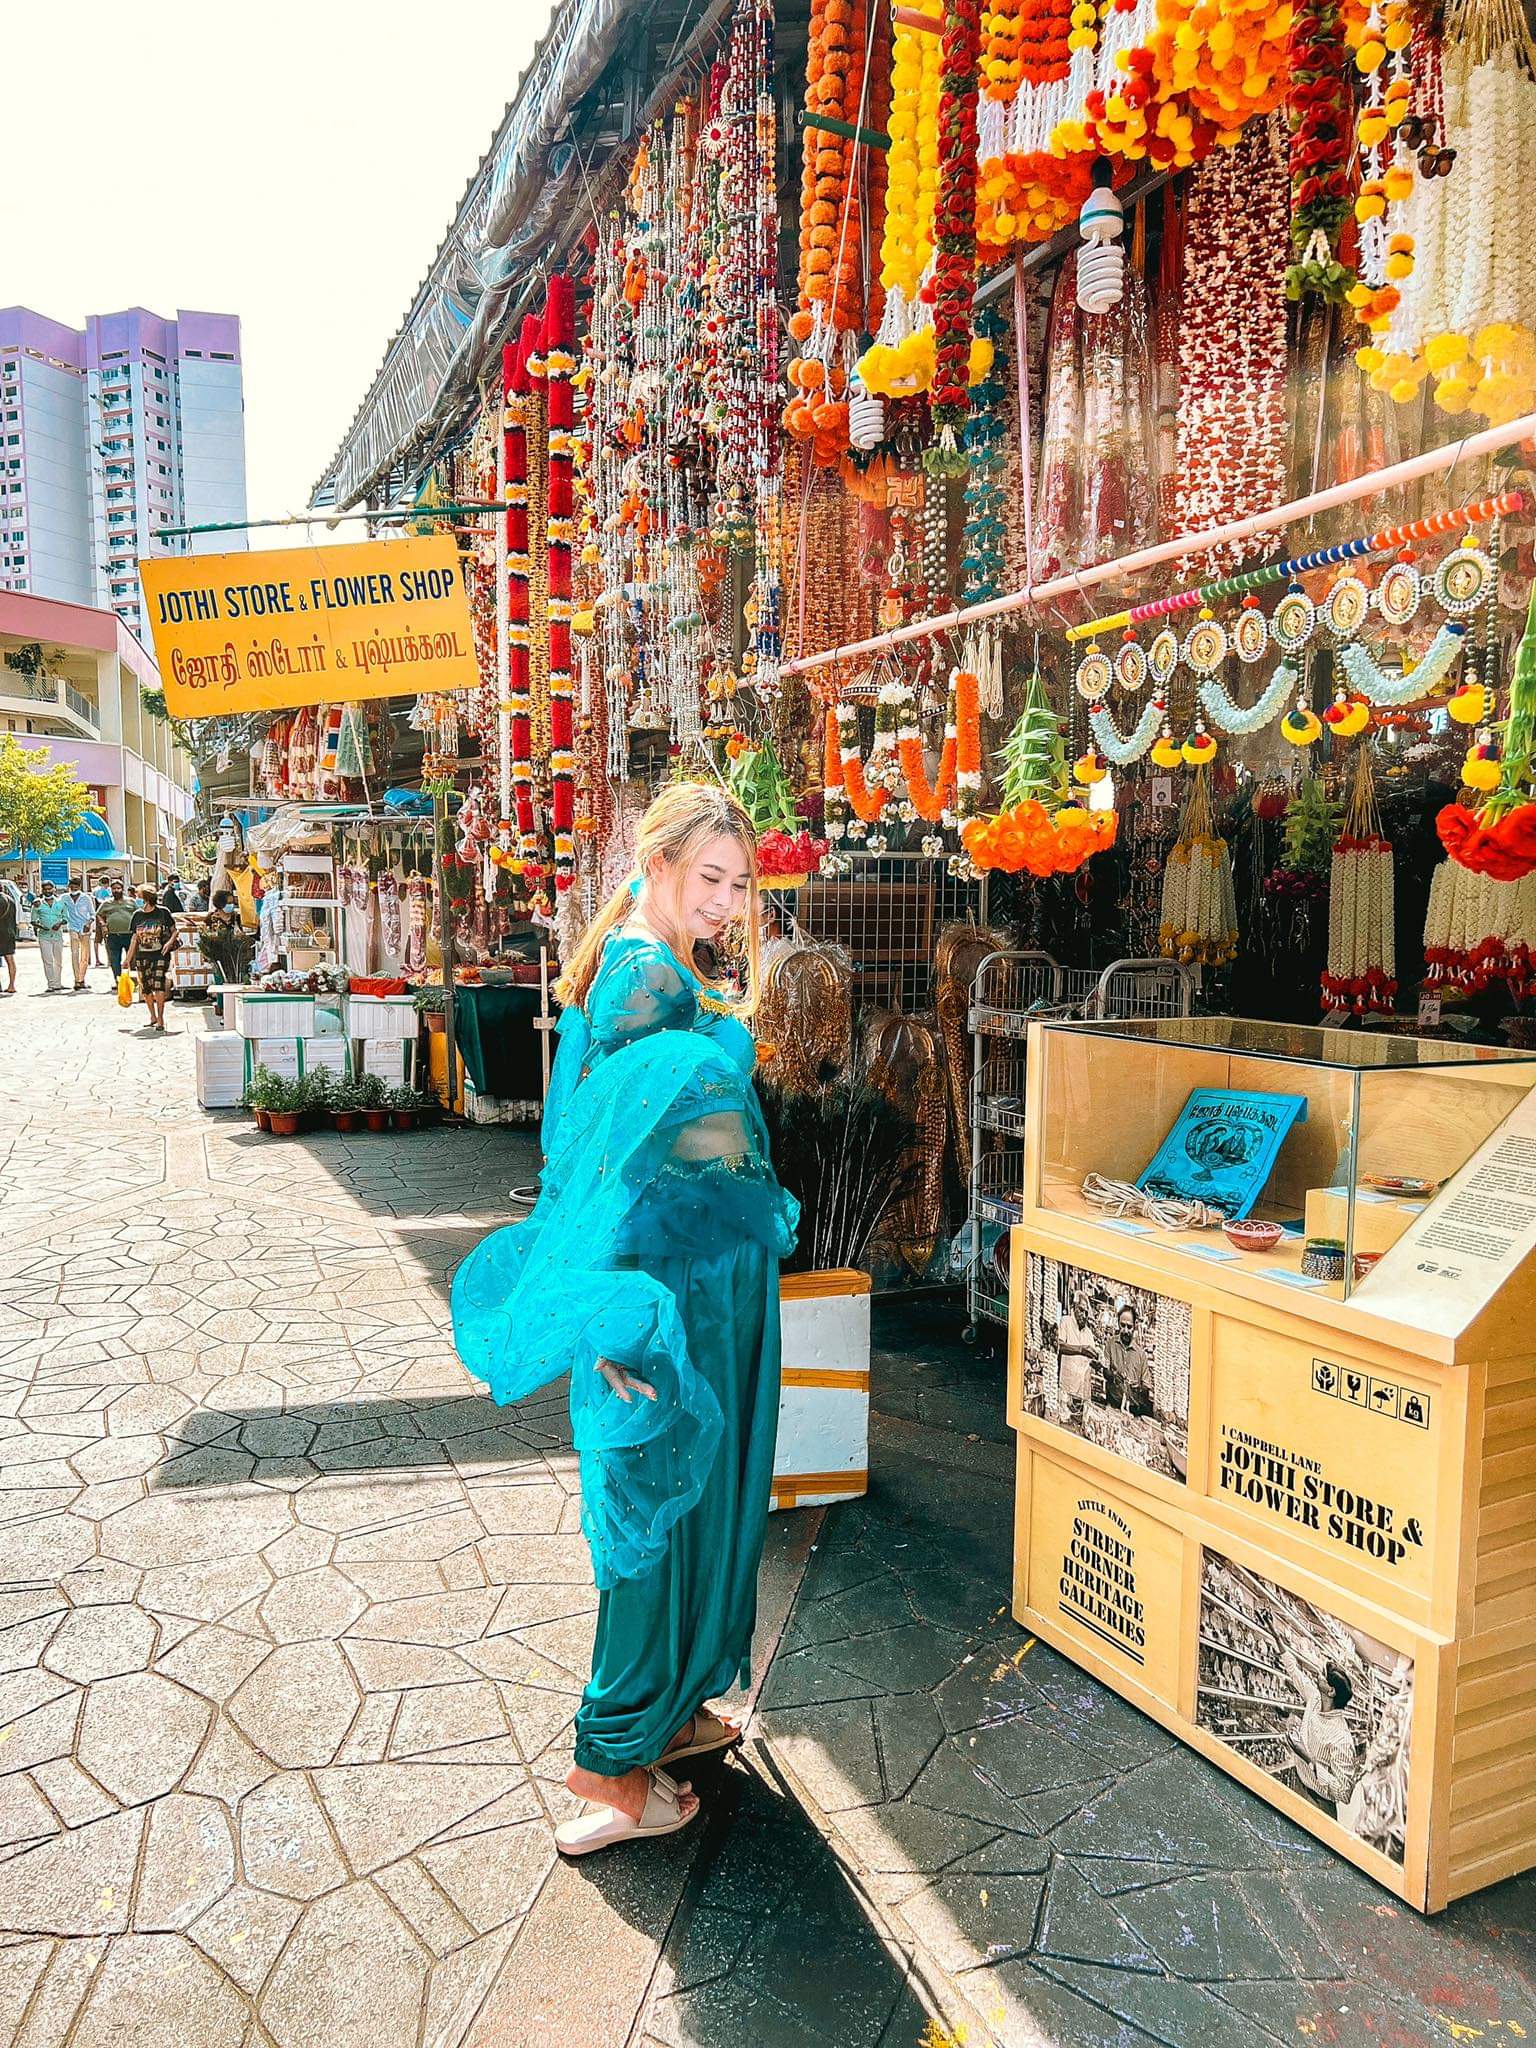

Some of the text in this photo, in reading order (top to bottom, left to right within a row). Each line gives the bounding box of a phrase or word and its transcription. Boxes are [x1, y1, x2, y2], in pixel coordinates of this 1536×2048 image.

[158, 568, 454, 624] JOTHI STORE & FLOWER SHOP
[171, 624, 467, 691] ஜோதி ஸ்டோர் & புஷ்பக்கடை
[1229, 1427, 1289, 1462] CAMPBELL
[1291, 1452, 1322, 1475] LANE
[1077, 1499, 1132, 1540] LITTLE INDIA
[1220, 1440, 1424, 1547] JOTHI STORE &
[1220, 1465, 1406, 1566] FLOWER SHOP
[1070, 1538, 1136, 1594] CORNER
[1072, 1517, 1135, 1568] STREET
[1059, 1577, 1145, 1647] GALLERIES
[1063, 1555, 1144, 1623] HERITAGE
